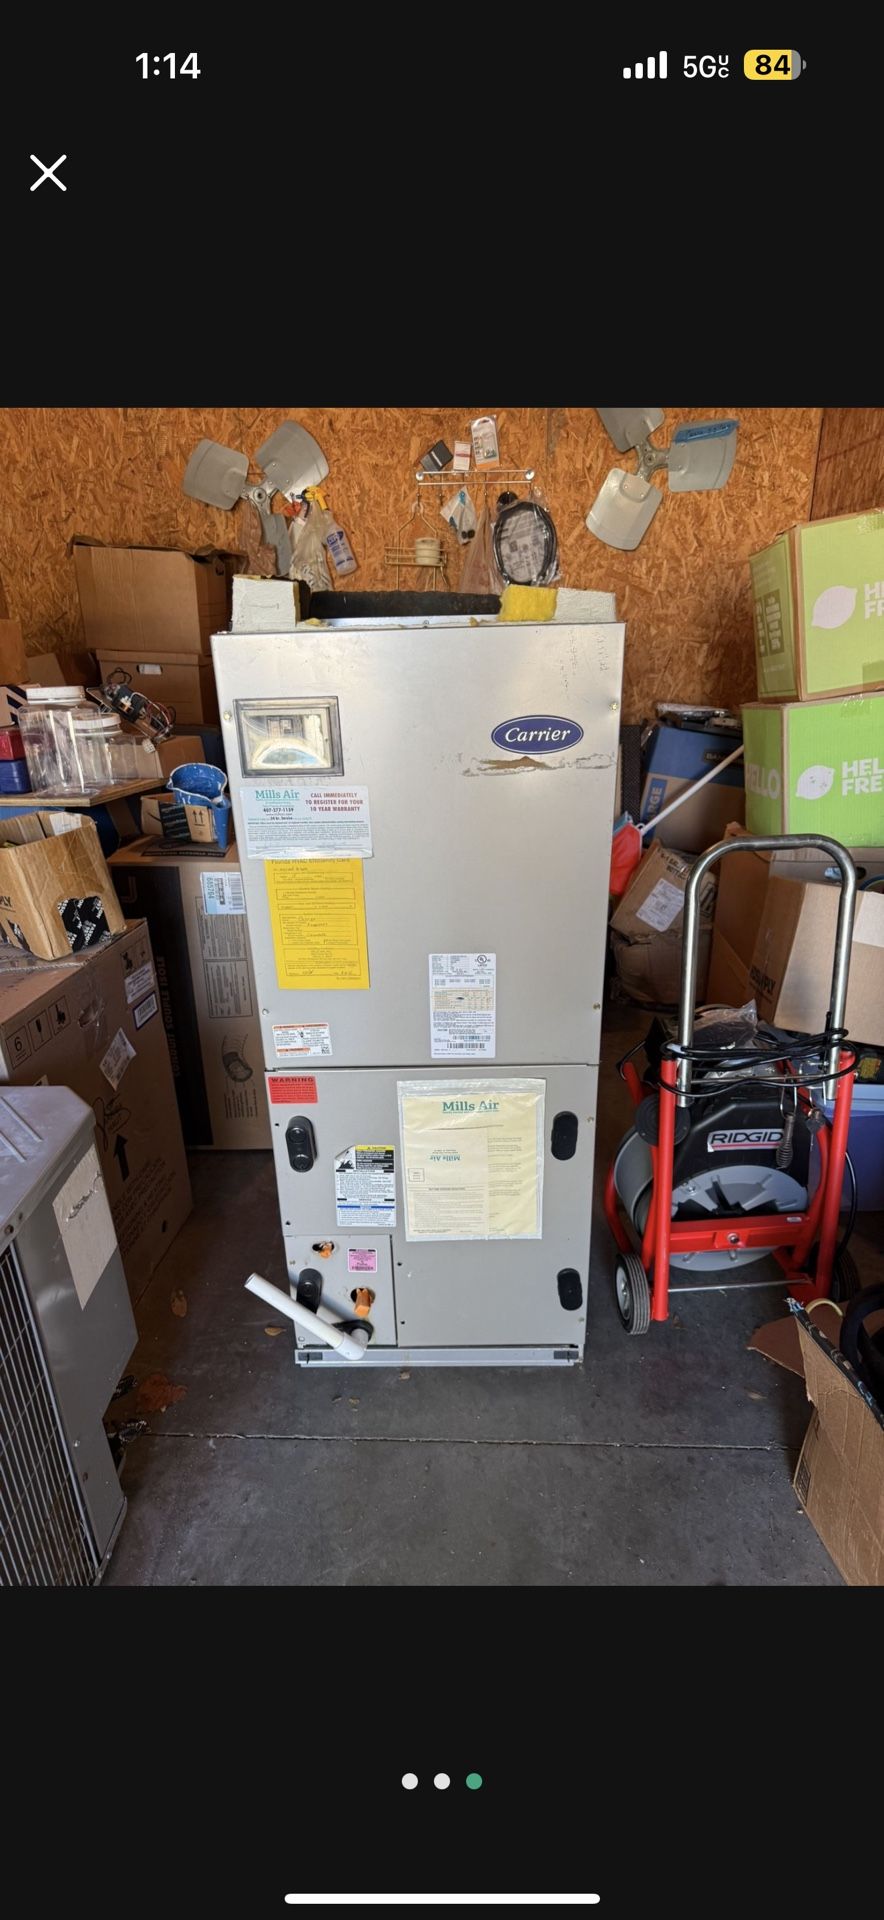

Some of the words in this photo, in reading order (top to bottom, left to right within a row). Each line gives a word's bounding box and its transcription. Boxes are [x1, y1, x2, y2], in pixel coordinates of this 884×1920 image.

[864, 581, 884, 601] H
[505, 727, 571, 743] Carrier
[842, 758, 884, 778] HEL
[842, 775, 884, 797] FRE
[255, 790, 281, 800] Mills
[283, 789, 300, 799] Air
[14, 1036, 23, 1052] 6
[442, 1101, 476, 1111] Mills
[479, 1099, 500, 1110] Air
[710, 1131, 784, 1145] RIDGID
